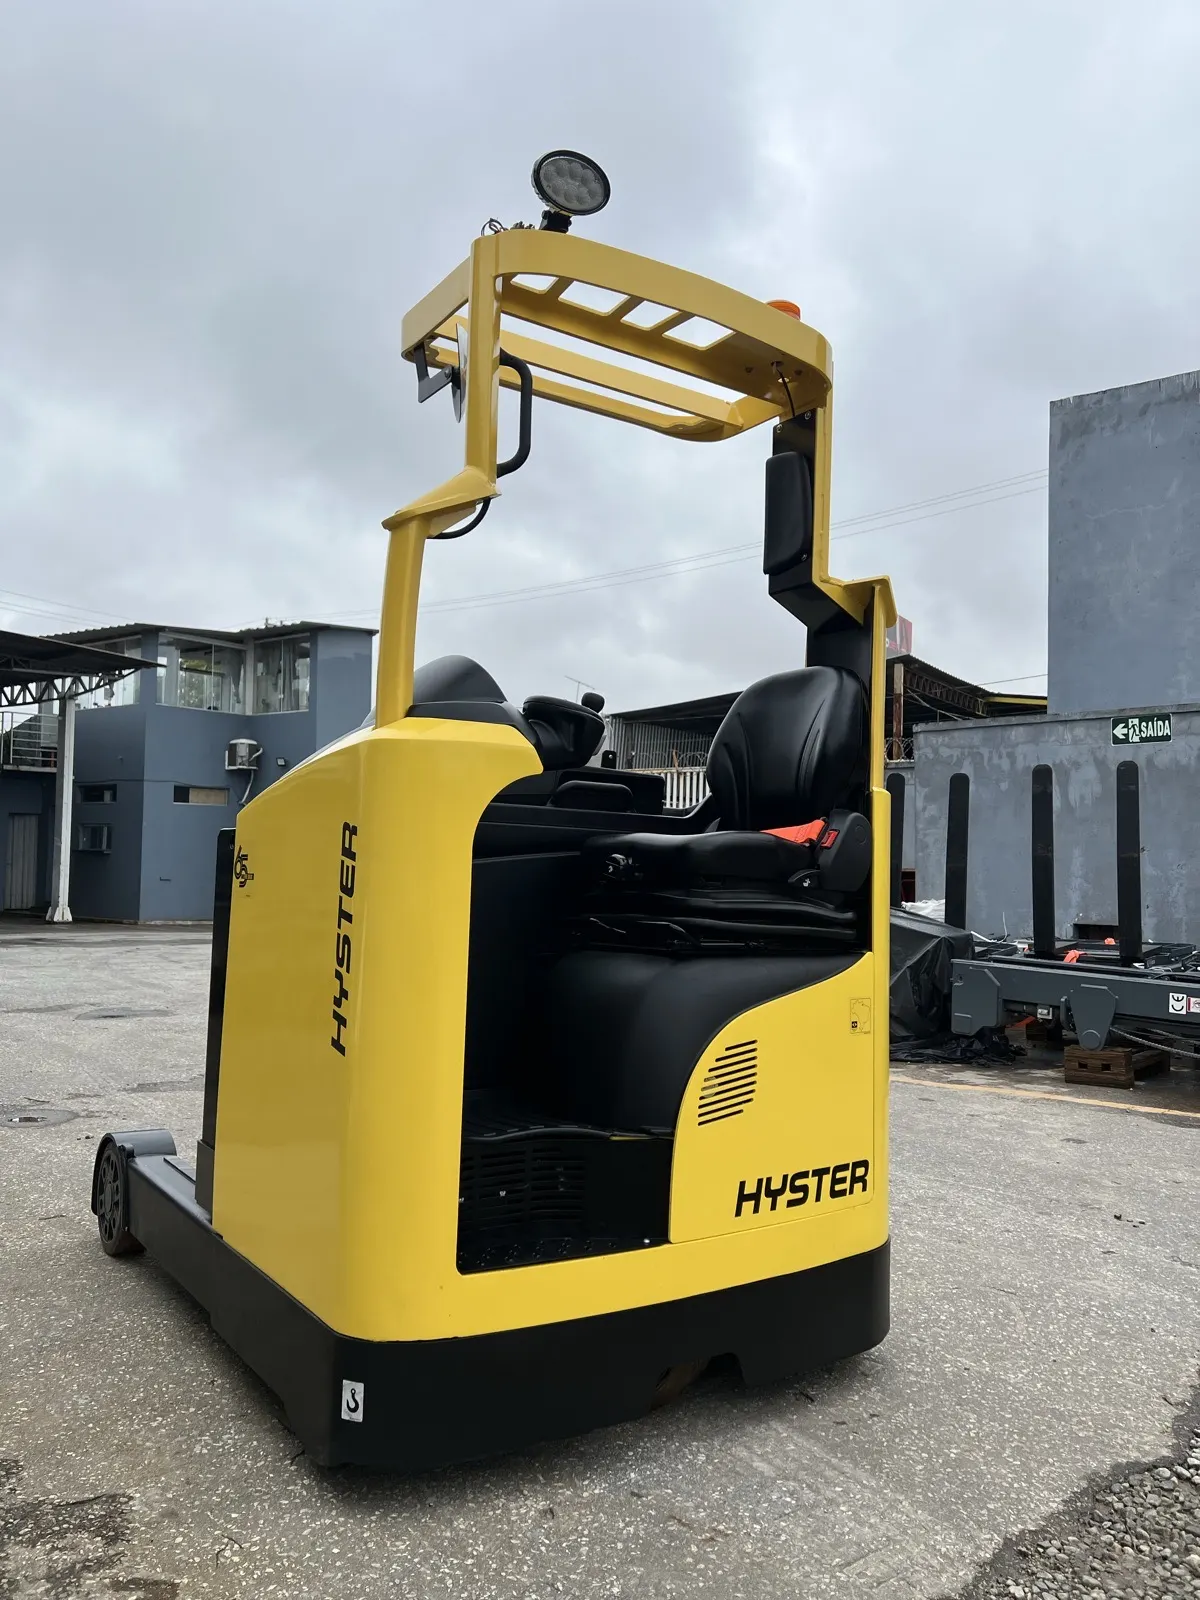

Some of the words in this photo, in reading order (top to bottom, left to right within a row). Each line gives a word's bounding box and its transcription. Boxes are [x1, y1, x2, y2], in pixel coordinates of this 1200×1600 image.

[1140, 717, 1171, 738] SAÍDA
[330, 821, 358, 1057] HYSTER
[1171, 994, 1185, 1012] CE
[734, 1159, 870, 1218] HYSTER
